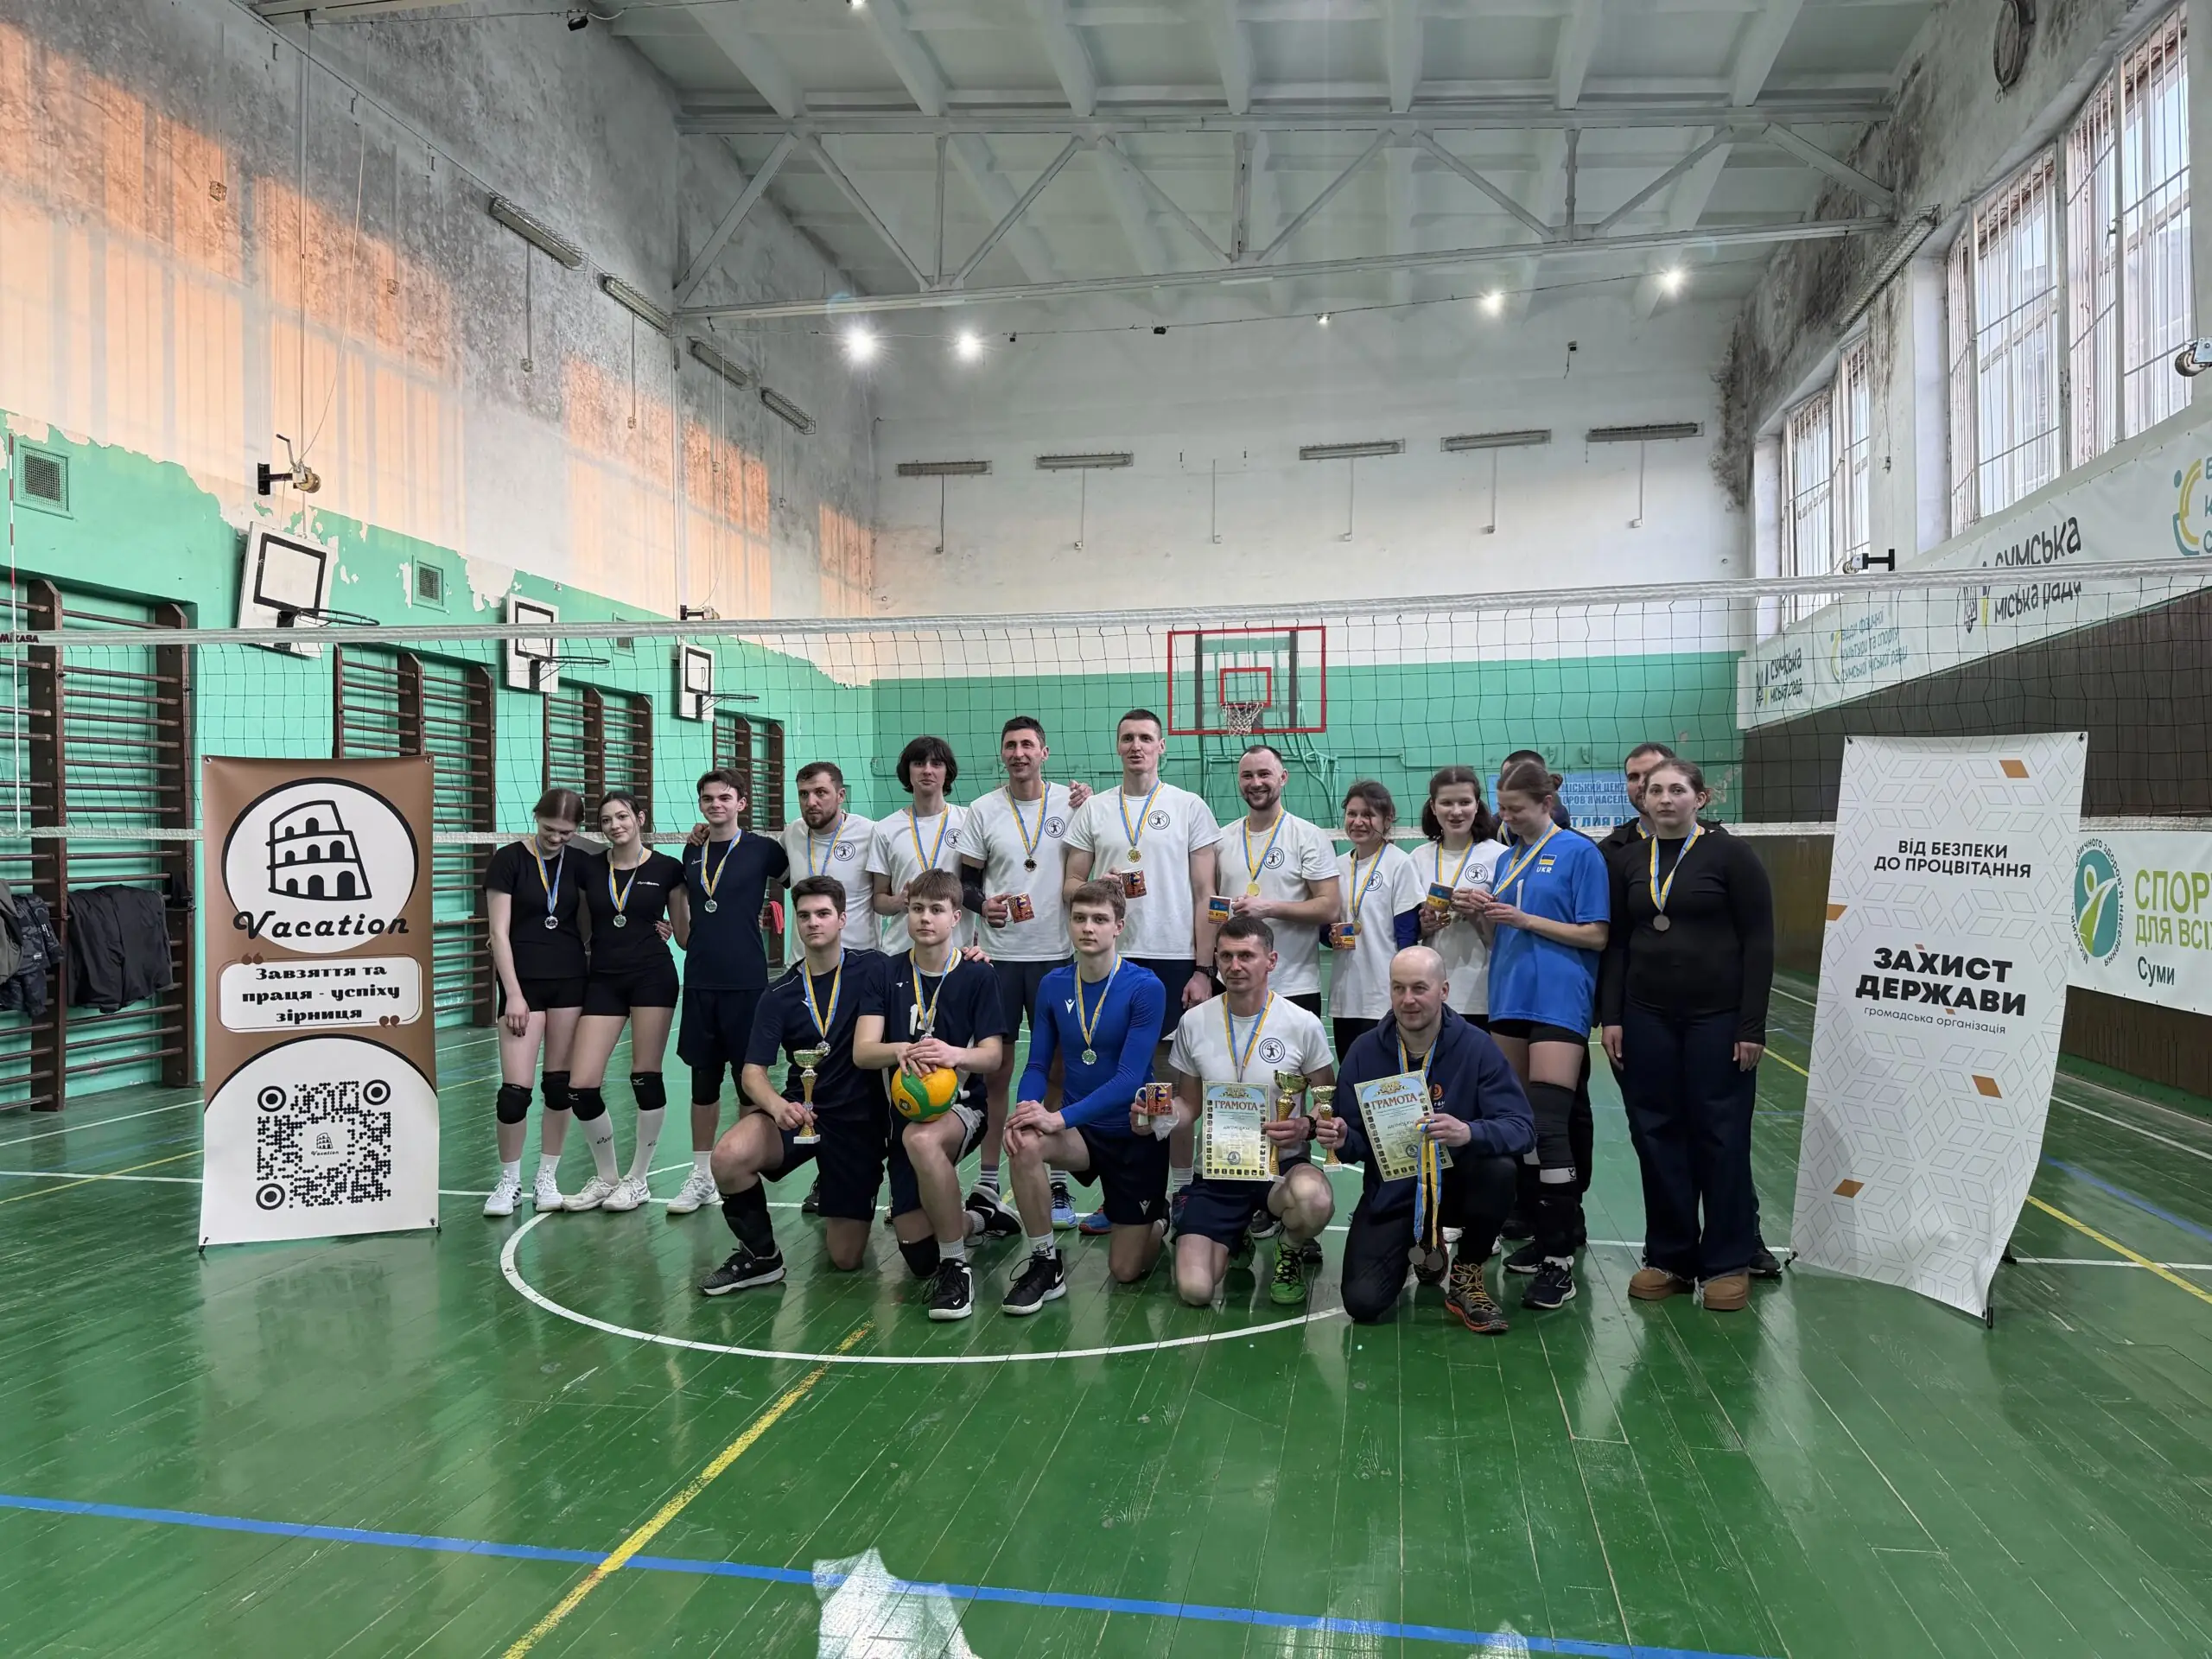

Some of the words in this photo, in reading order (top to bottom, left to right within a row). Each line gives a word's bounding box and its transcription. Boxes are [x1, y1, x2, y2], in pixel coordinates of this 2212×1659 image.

[1603, 783, 1626, 792] ЦЕНТ
[1595, 795, 1629, 805] НАСЕЛЕ
[1931, 842, 2008, 859] БЕЗПЕКИ
[1873, 856, 1901, 871] ДО
[1904, 857, 2031, 878] ПРОЦВІТАННЯ
[2134, 868, 2212, 914] СПОР
[232, 910, 410, 940] Vacation
[2135, 914, 2173, 947] ДЛЯ
[2177, 918, 2212, 950] ВСІ
[256, 967, 357, 981] Завзяття
[362, 965, 388, 976] та
[1872, 947, 2013, 983] ЗАХИСТ
[2137, 956, 2175, 988] Суми
[242, 989, 314, 1006] праця
[330, 983, 401, 1002] успіху
[1855, 974, 2027, 1017] ДЕРЖАВИ
[276, 1008, 363, 1025] зірниця
[1864, 1006, 1934, 1024] громадська
[1936, 1016, 2006, 1034] організація
[1214, 1100, 1259, 1111] ГРАМОТА
[1370, 1092, 1418, 1110] ГРАМОТА
